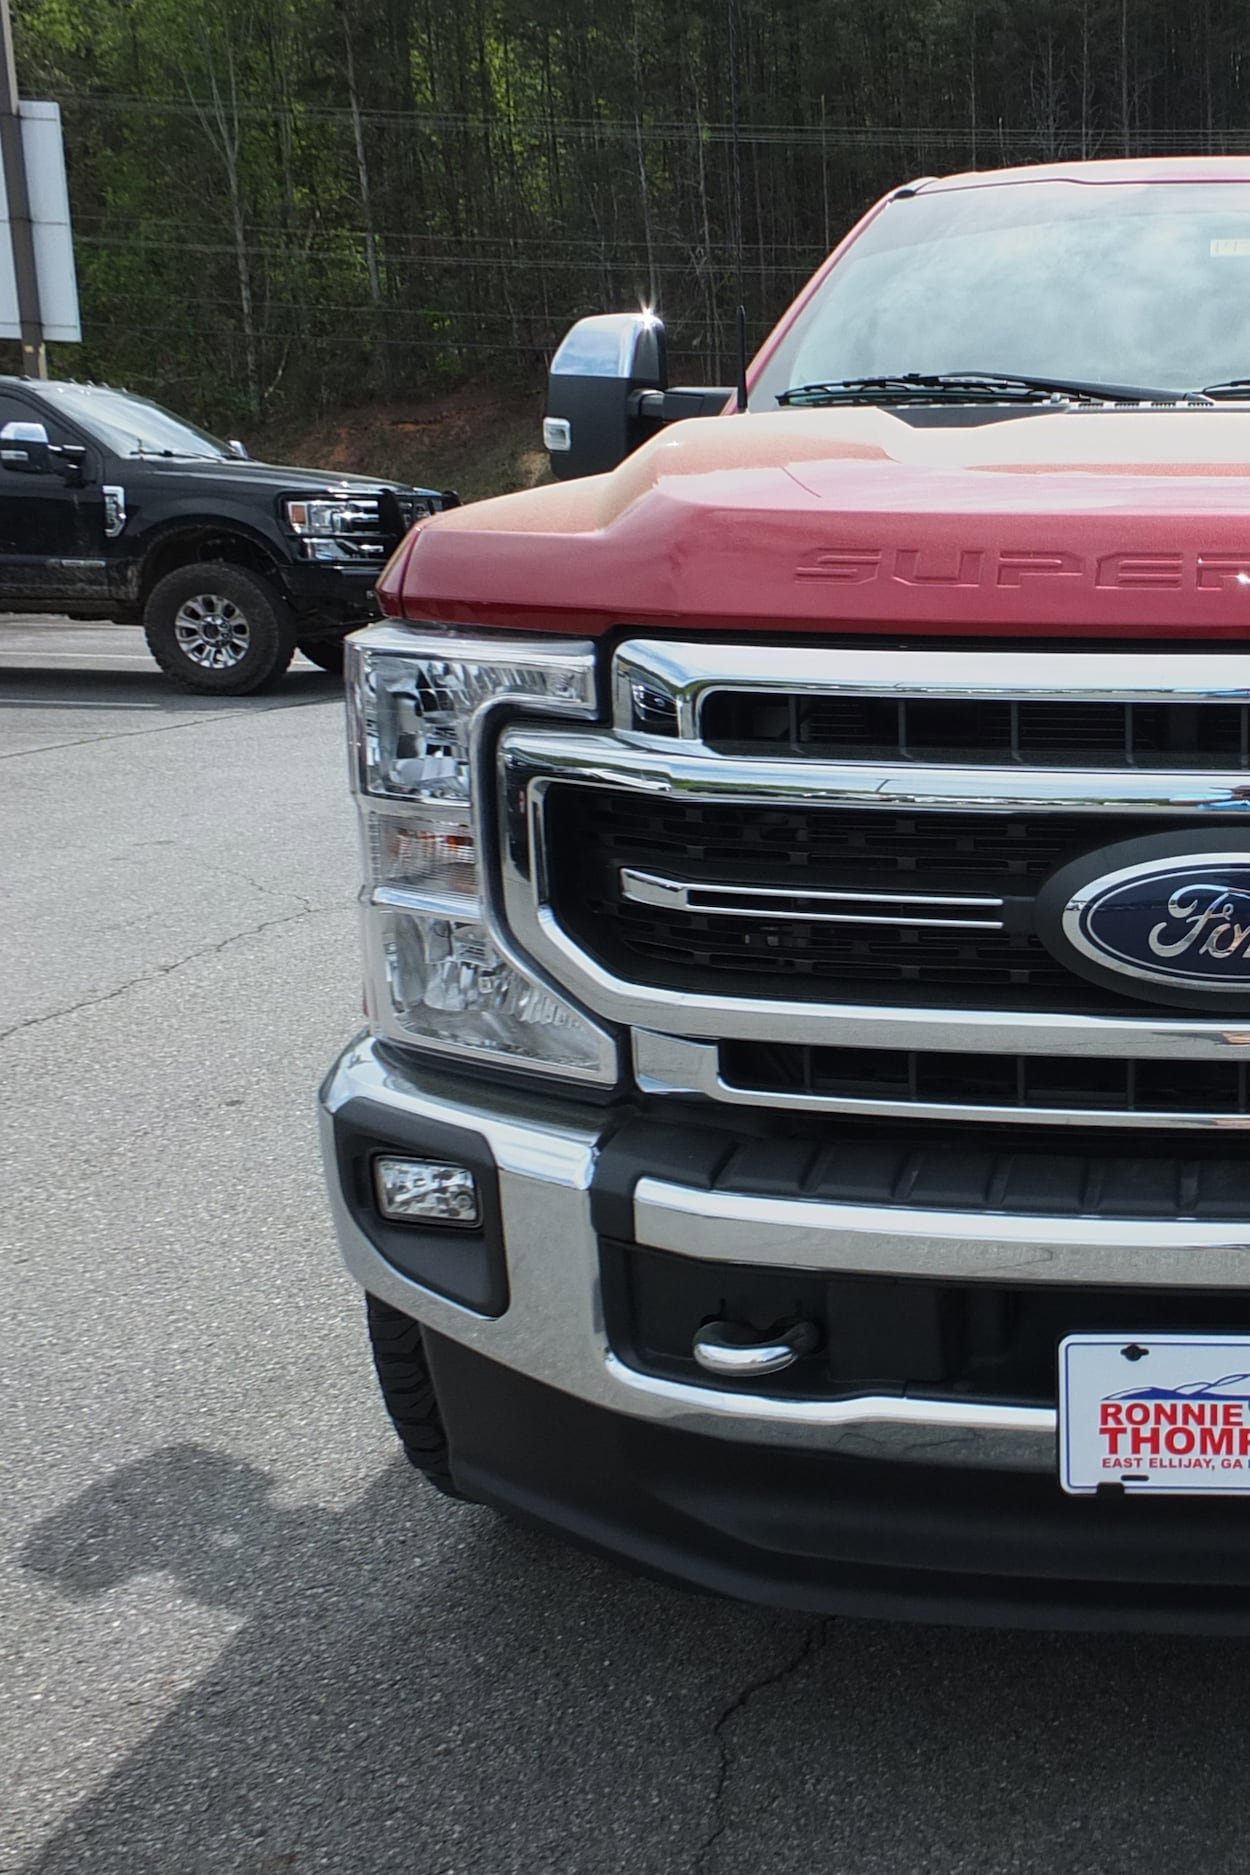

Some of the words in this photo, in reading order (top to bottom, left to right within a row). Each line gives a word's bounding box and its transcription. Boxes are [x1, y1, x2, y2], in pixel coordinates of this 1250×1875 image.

[1100, 1402, 1244, 1427] RONNIE
[1101, 1457, 1144, 1469] EAST
[1148, 1457, 1216, 1471] ELLIJAY,
[1220, 1458, 1244, 1470] GA
